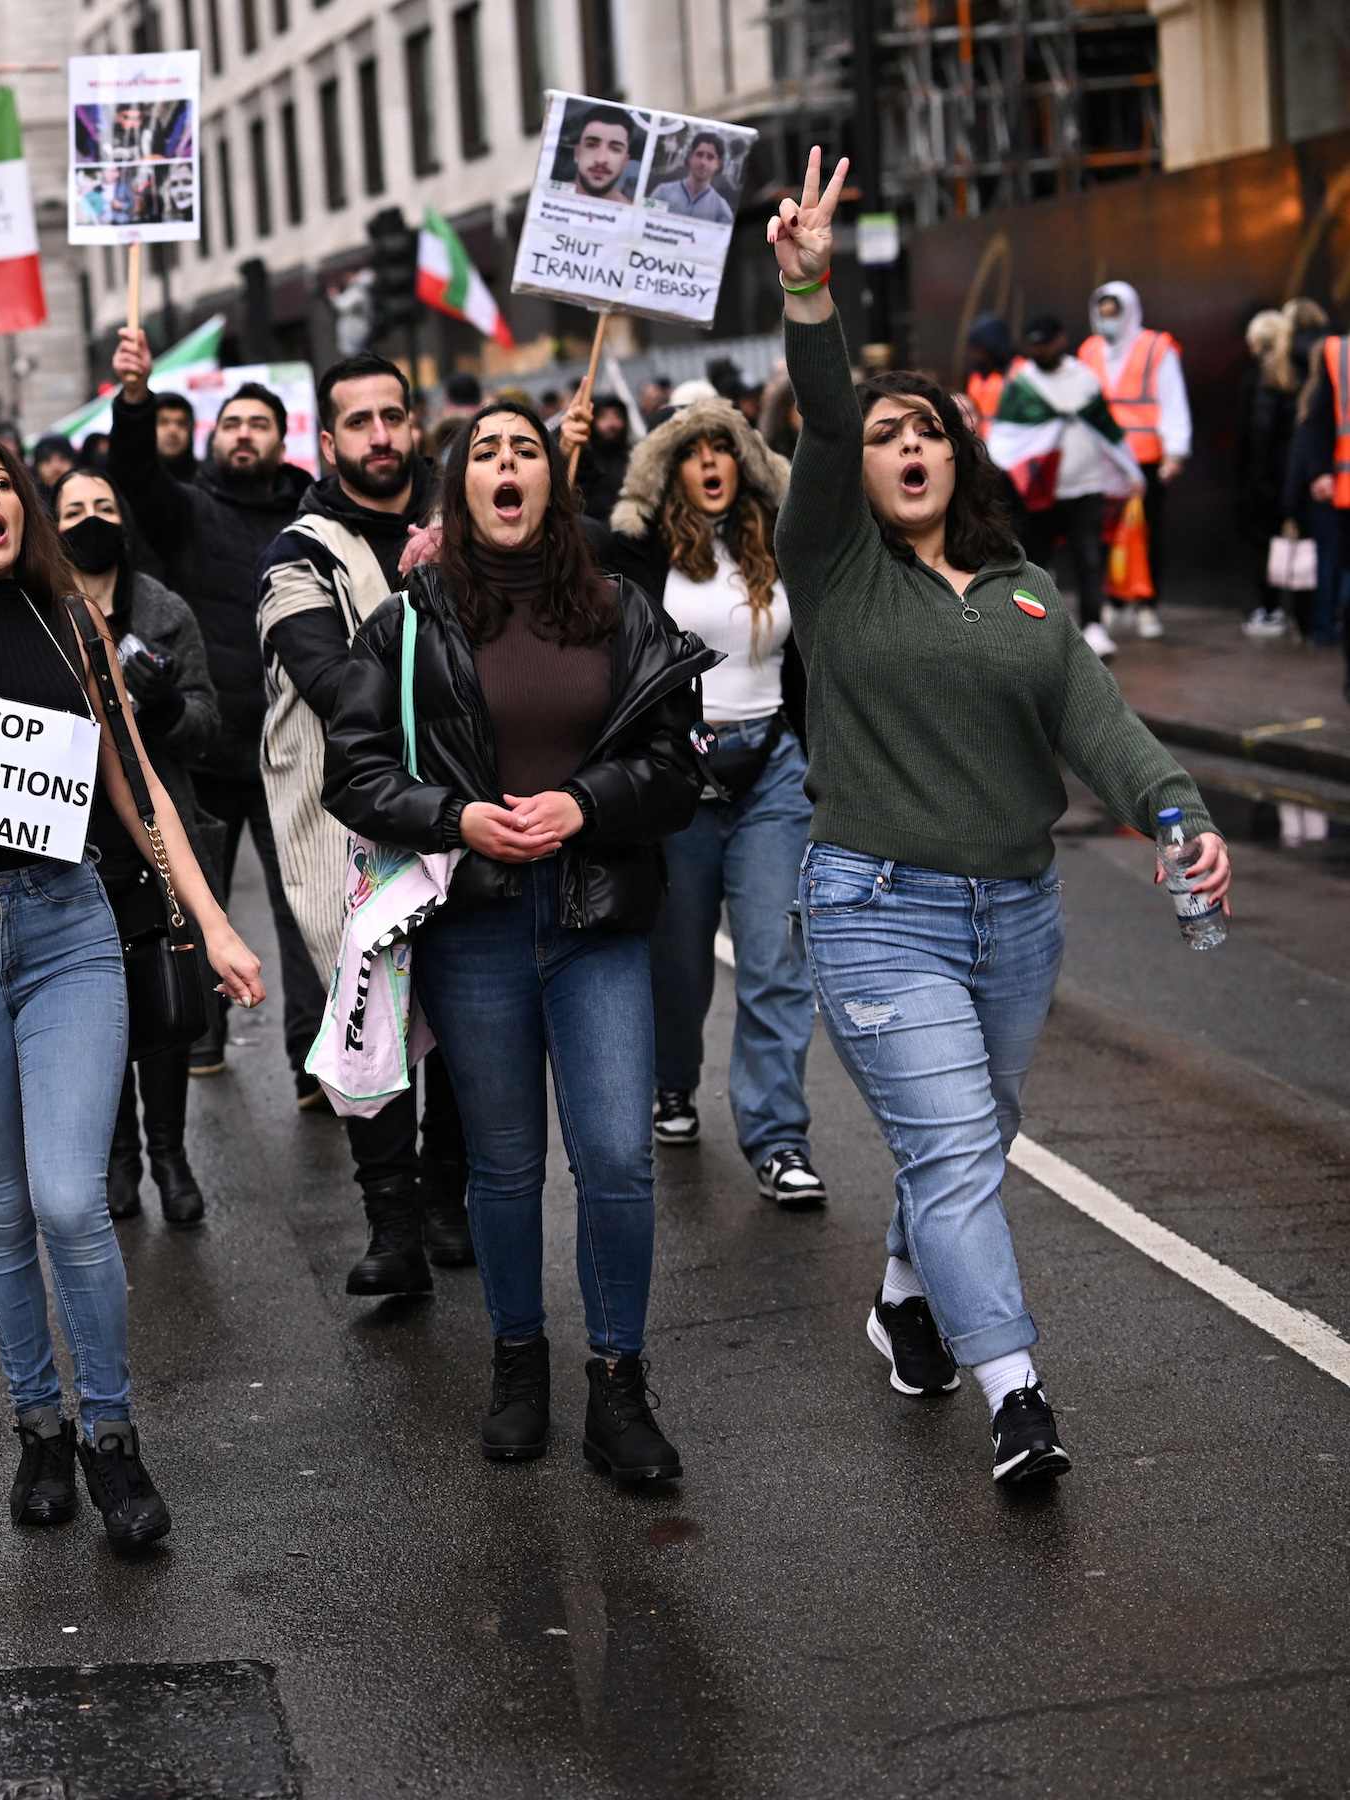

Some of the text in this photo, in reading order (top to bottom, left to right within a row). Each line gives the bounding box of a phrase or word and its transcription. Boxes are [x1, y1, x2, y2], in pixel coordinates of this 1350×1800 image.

[530, 252, 711, 302] IRANIAN EMBASSY
[551, 234, 696, 279] SHUT DOWN
